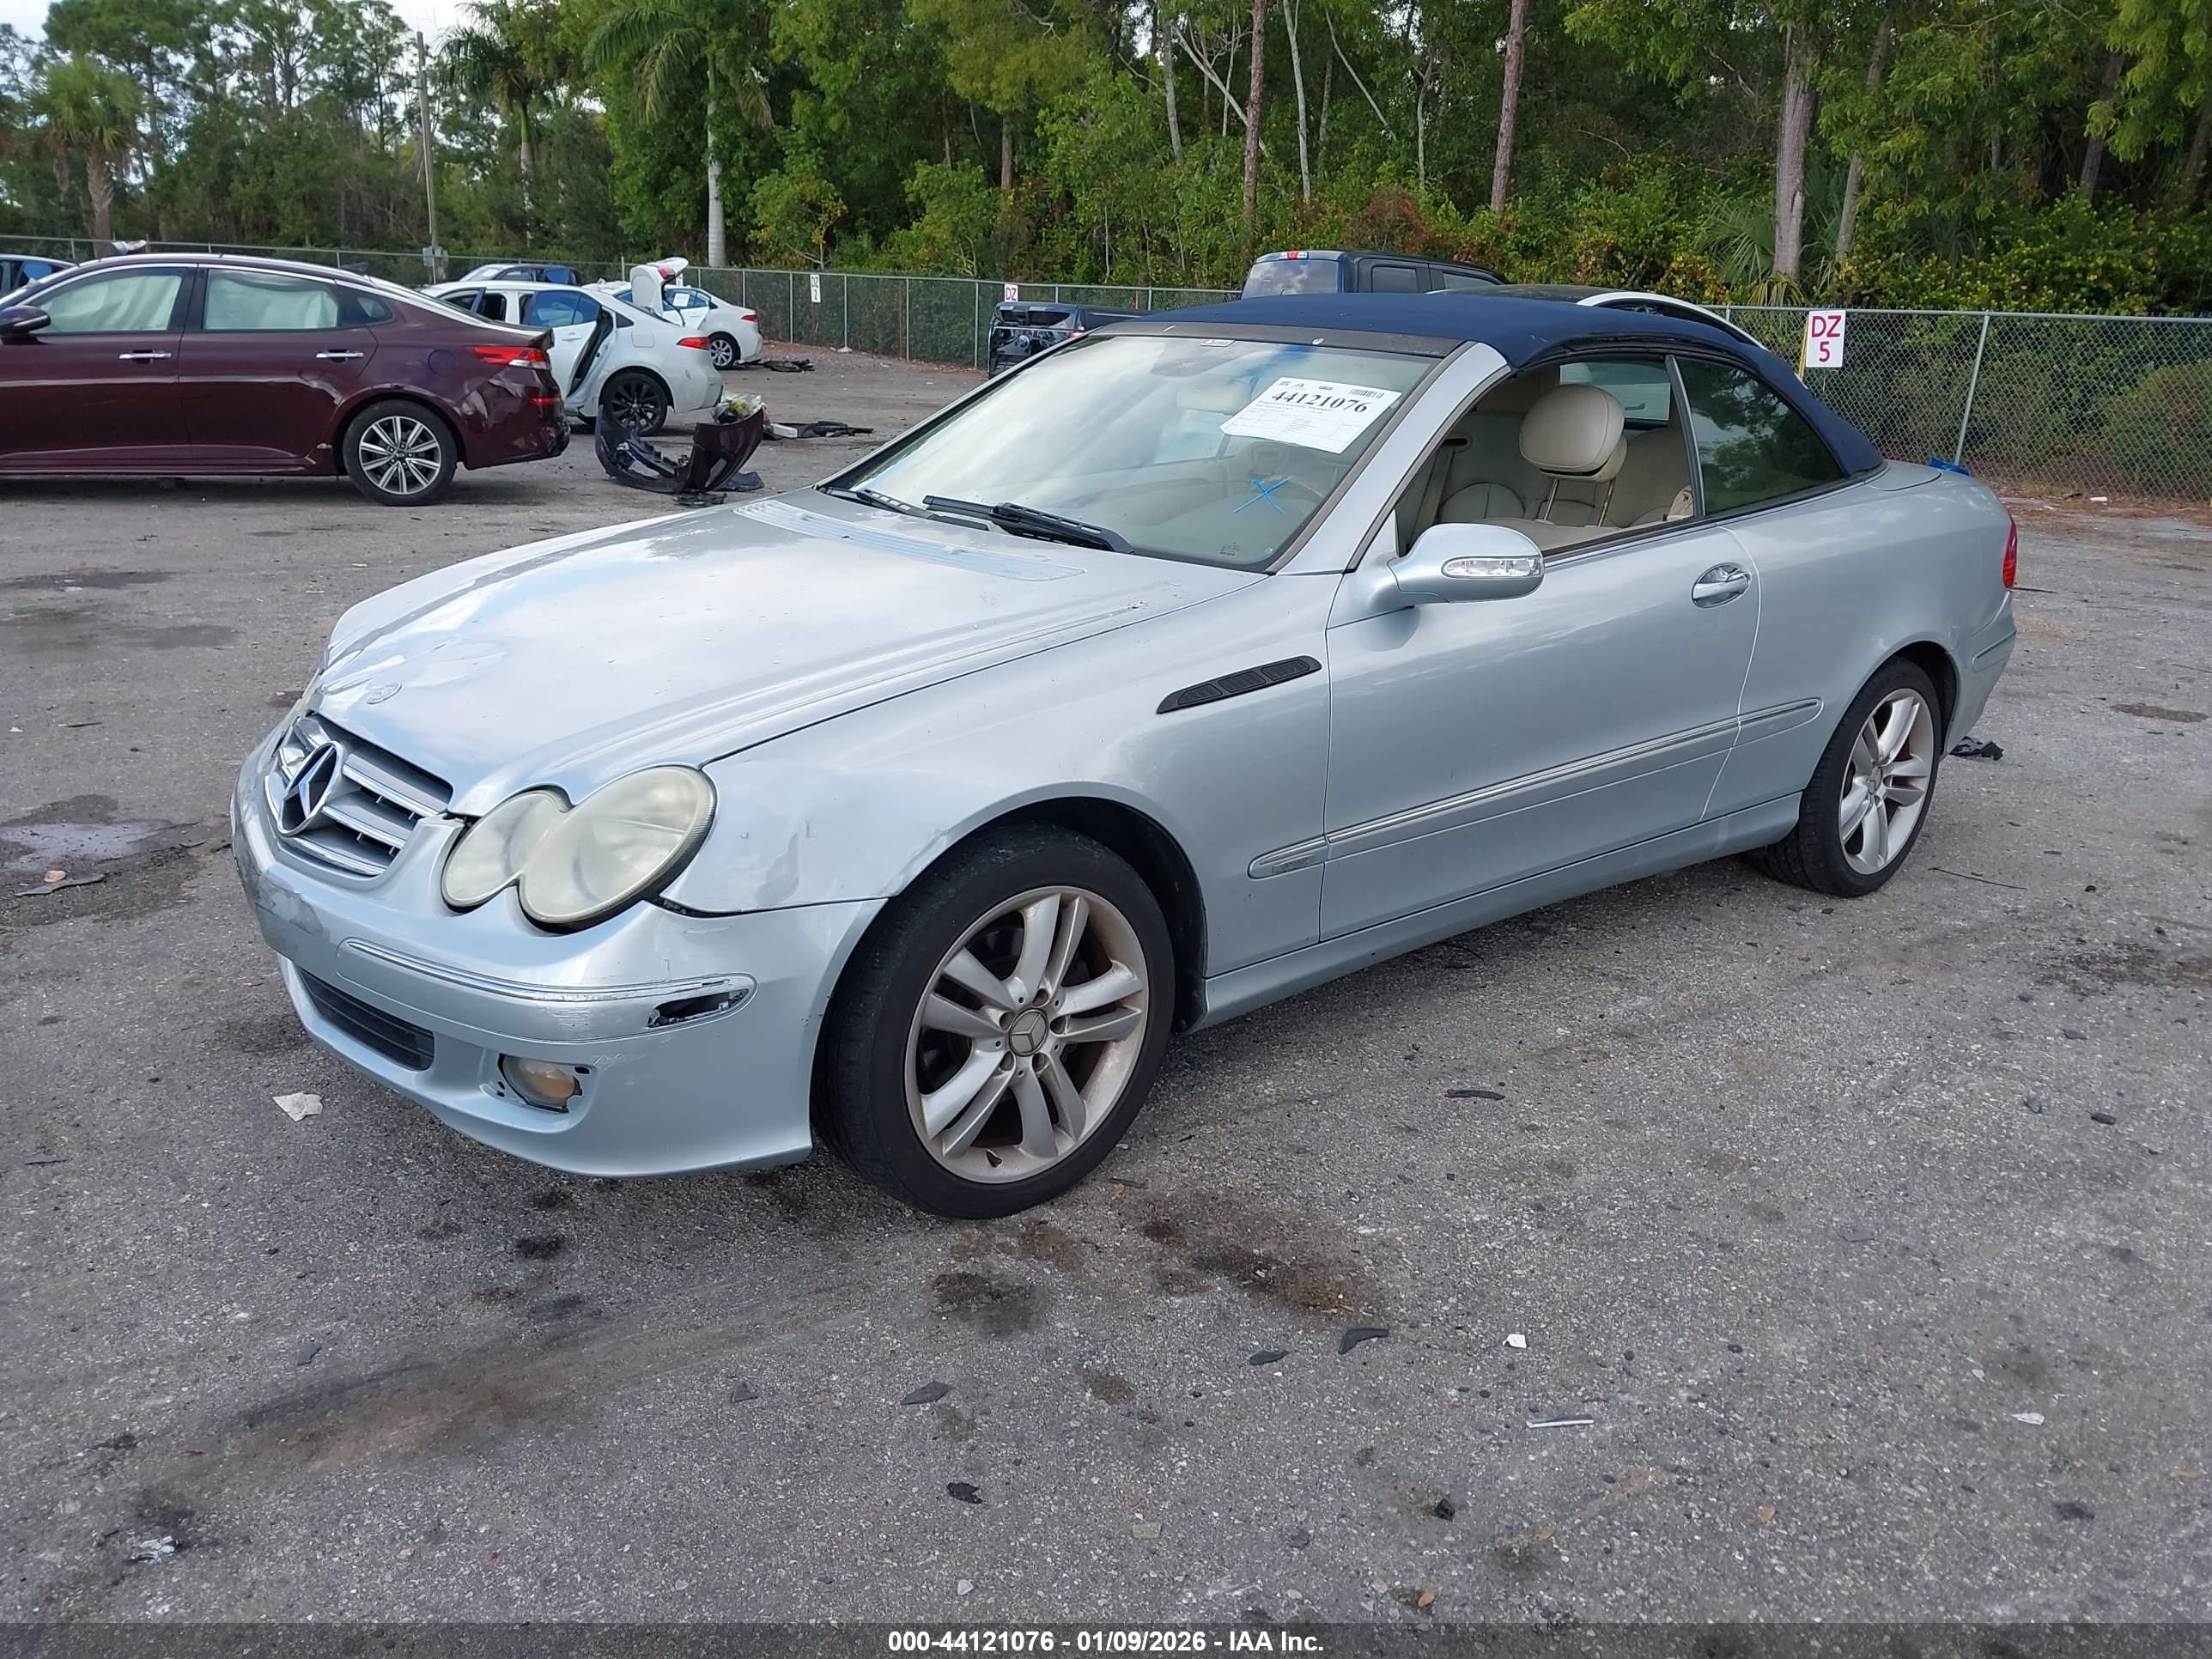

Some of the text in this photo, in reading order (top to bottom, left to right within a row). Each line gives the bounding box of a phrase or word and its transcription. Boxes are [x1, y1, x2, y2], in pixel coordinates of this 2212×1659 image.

[1006, 287, 1017, 301] DZ
[1812, 315, 1842, 337] DZ
[1819, 341, 1831, 362] 5
[1271, 391, 1373, 413] 44121076
